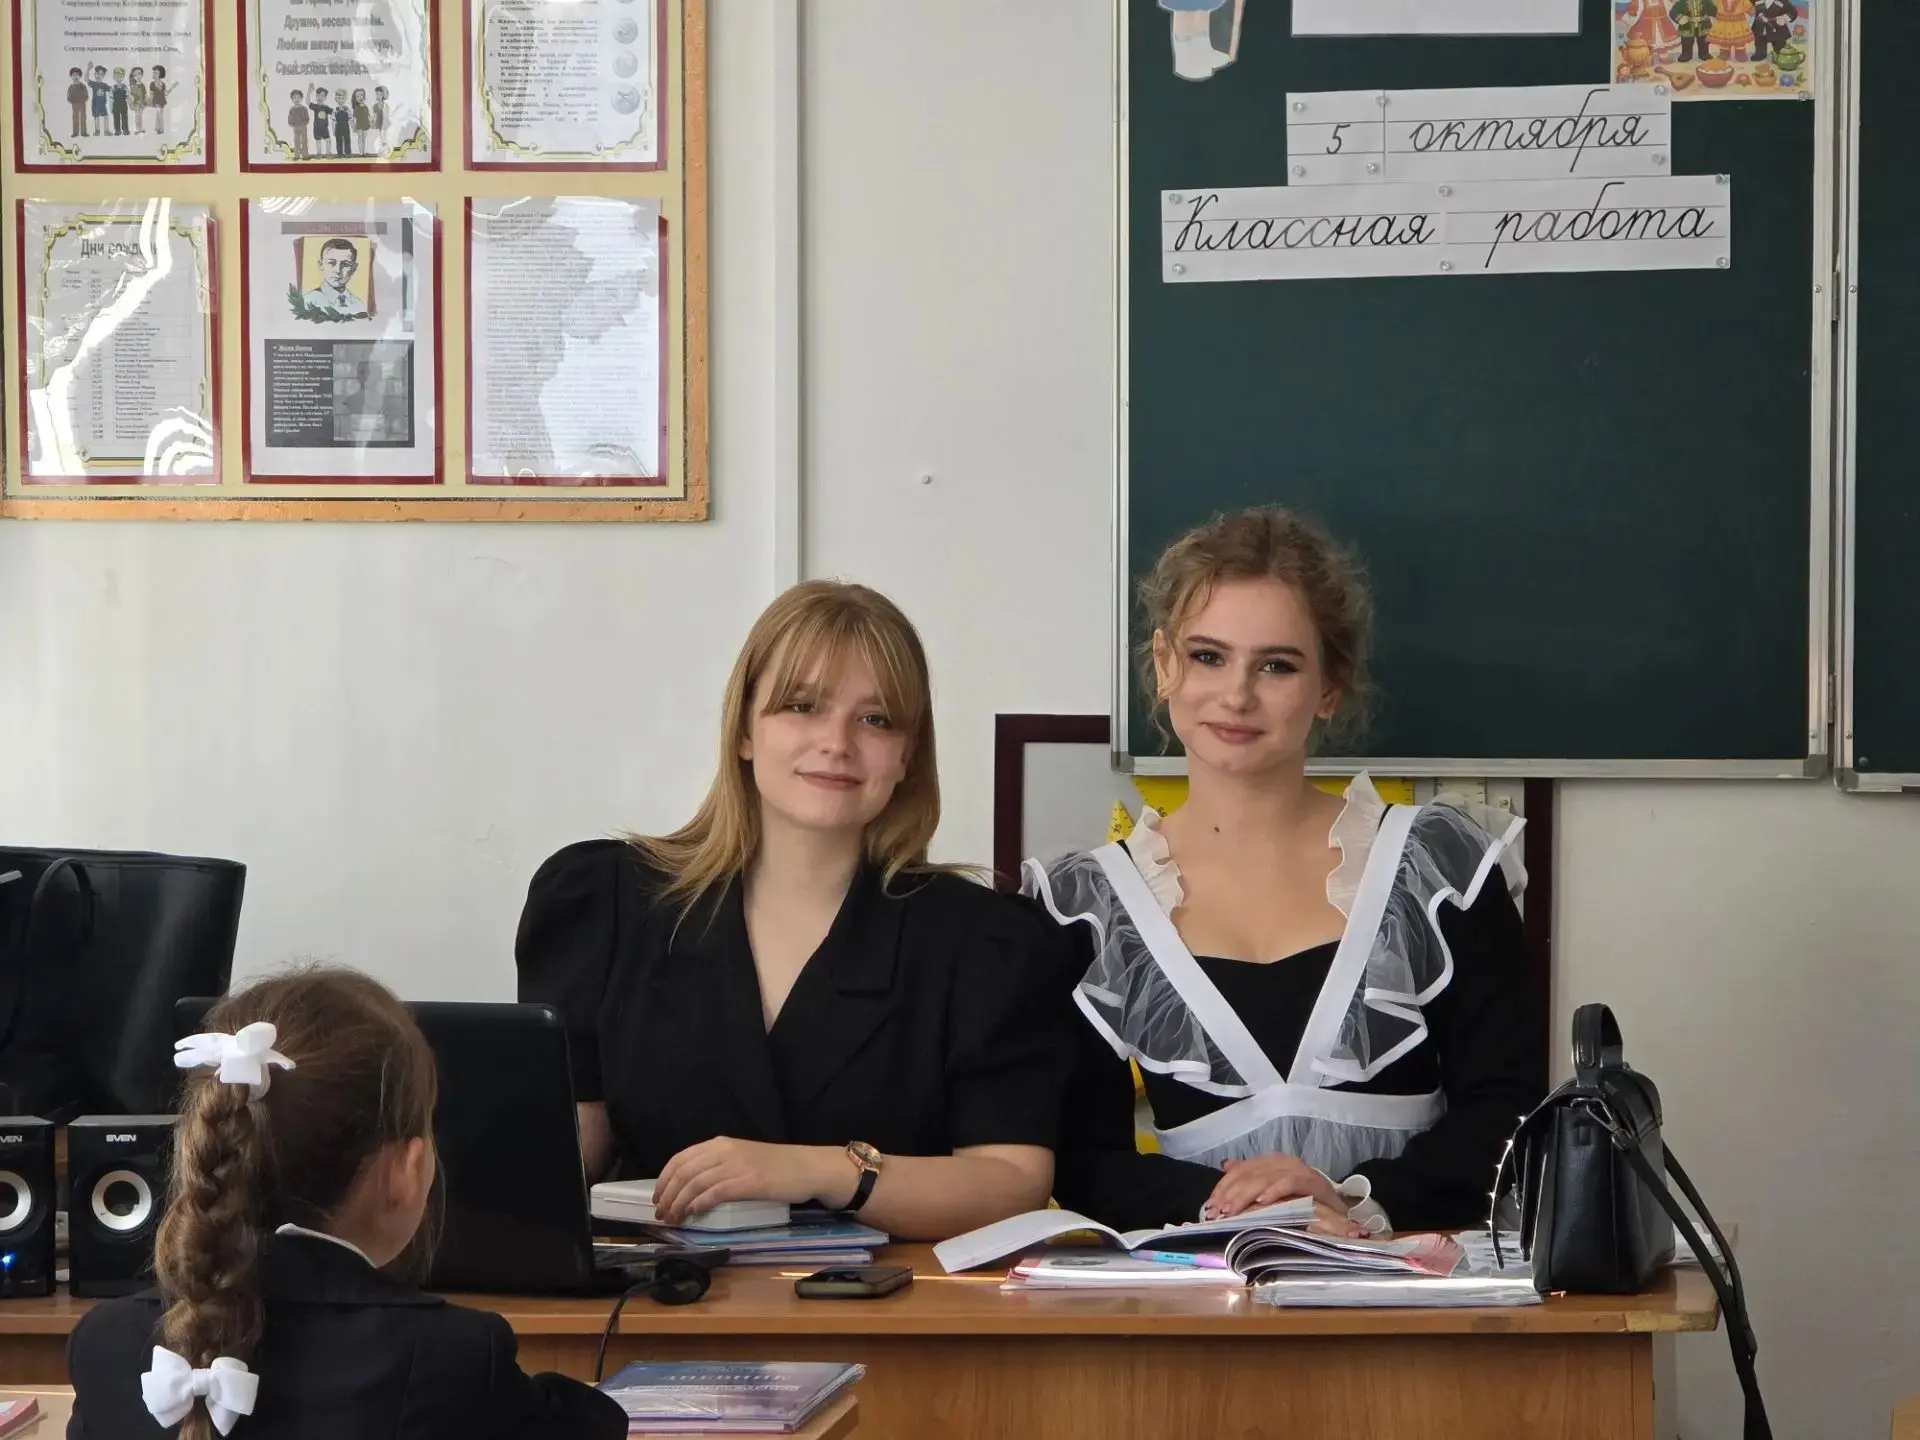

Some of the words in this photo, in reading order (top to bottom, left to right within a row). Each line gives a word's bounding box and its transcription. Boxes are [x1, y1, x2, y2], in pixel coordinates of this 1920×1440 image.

[1326, 123, 1350, 154] 5
[1409, 88, 1651, 172] октября
[81, 238, 104, 258] Дни
[1174, 192, 1436, 251] Классная
[1485, 181, 1715, 267] работа
[106, 1134, 137, 1142] SVEN
